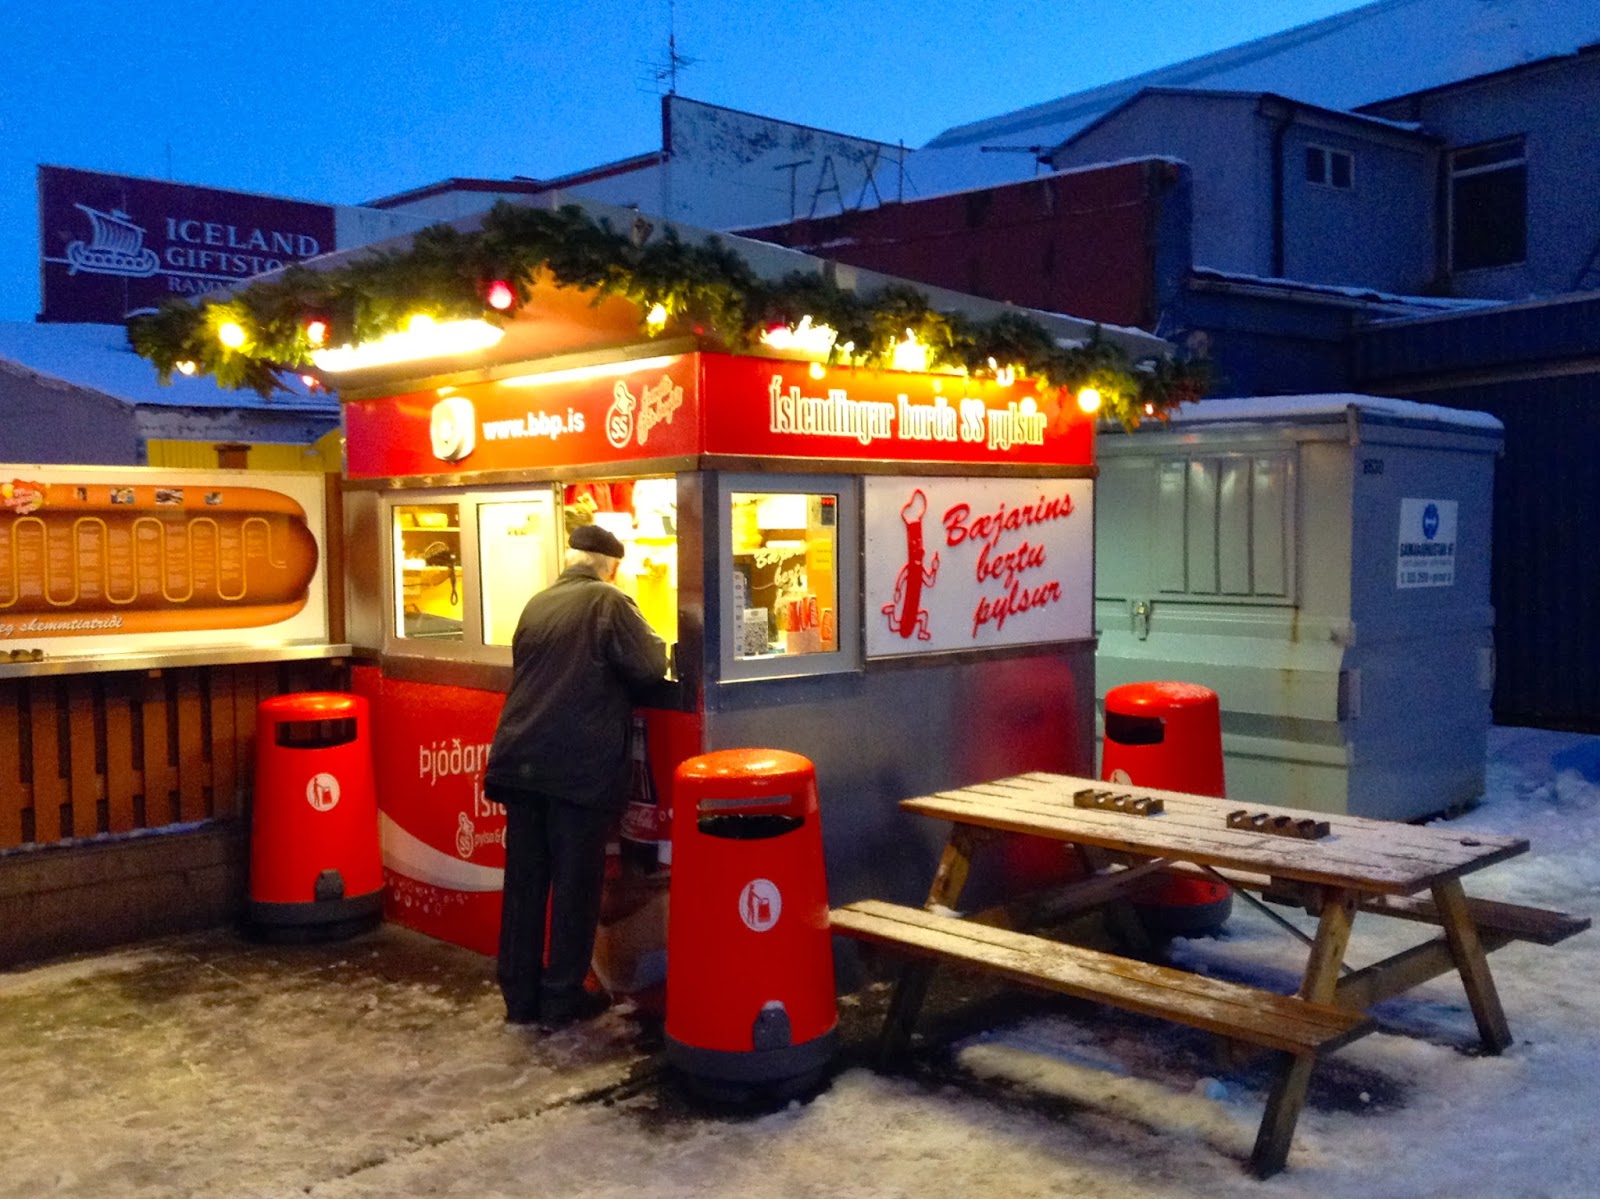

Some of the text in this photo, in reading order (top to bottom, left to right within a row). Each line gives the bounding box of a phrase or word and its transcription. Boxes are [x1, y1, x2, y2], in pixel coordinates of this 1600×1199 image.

[165, 216, 320, 257] ICELAND
[482, 407, 586, 441] www.bbp.is
[610, 416, 629, 439] SS
[769, 374, 896, 445] Íslendingar
[960, 398, 986, 443] SS
[943, 493, 1075, 547] Bæjarins
[976, 541, 1045, 589] beztu
[972, 580, 1062, 639] pylsur
